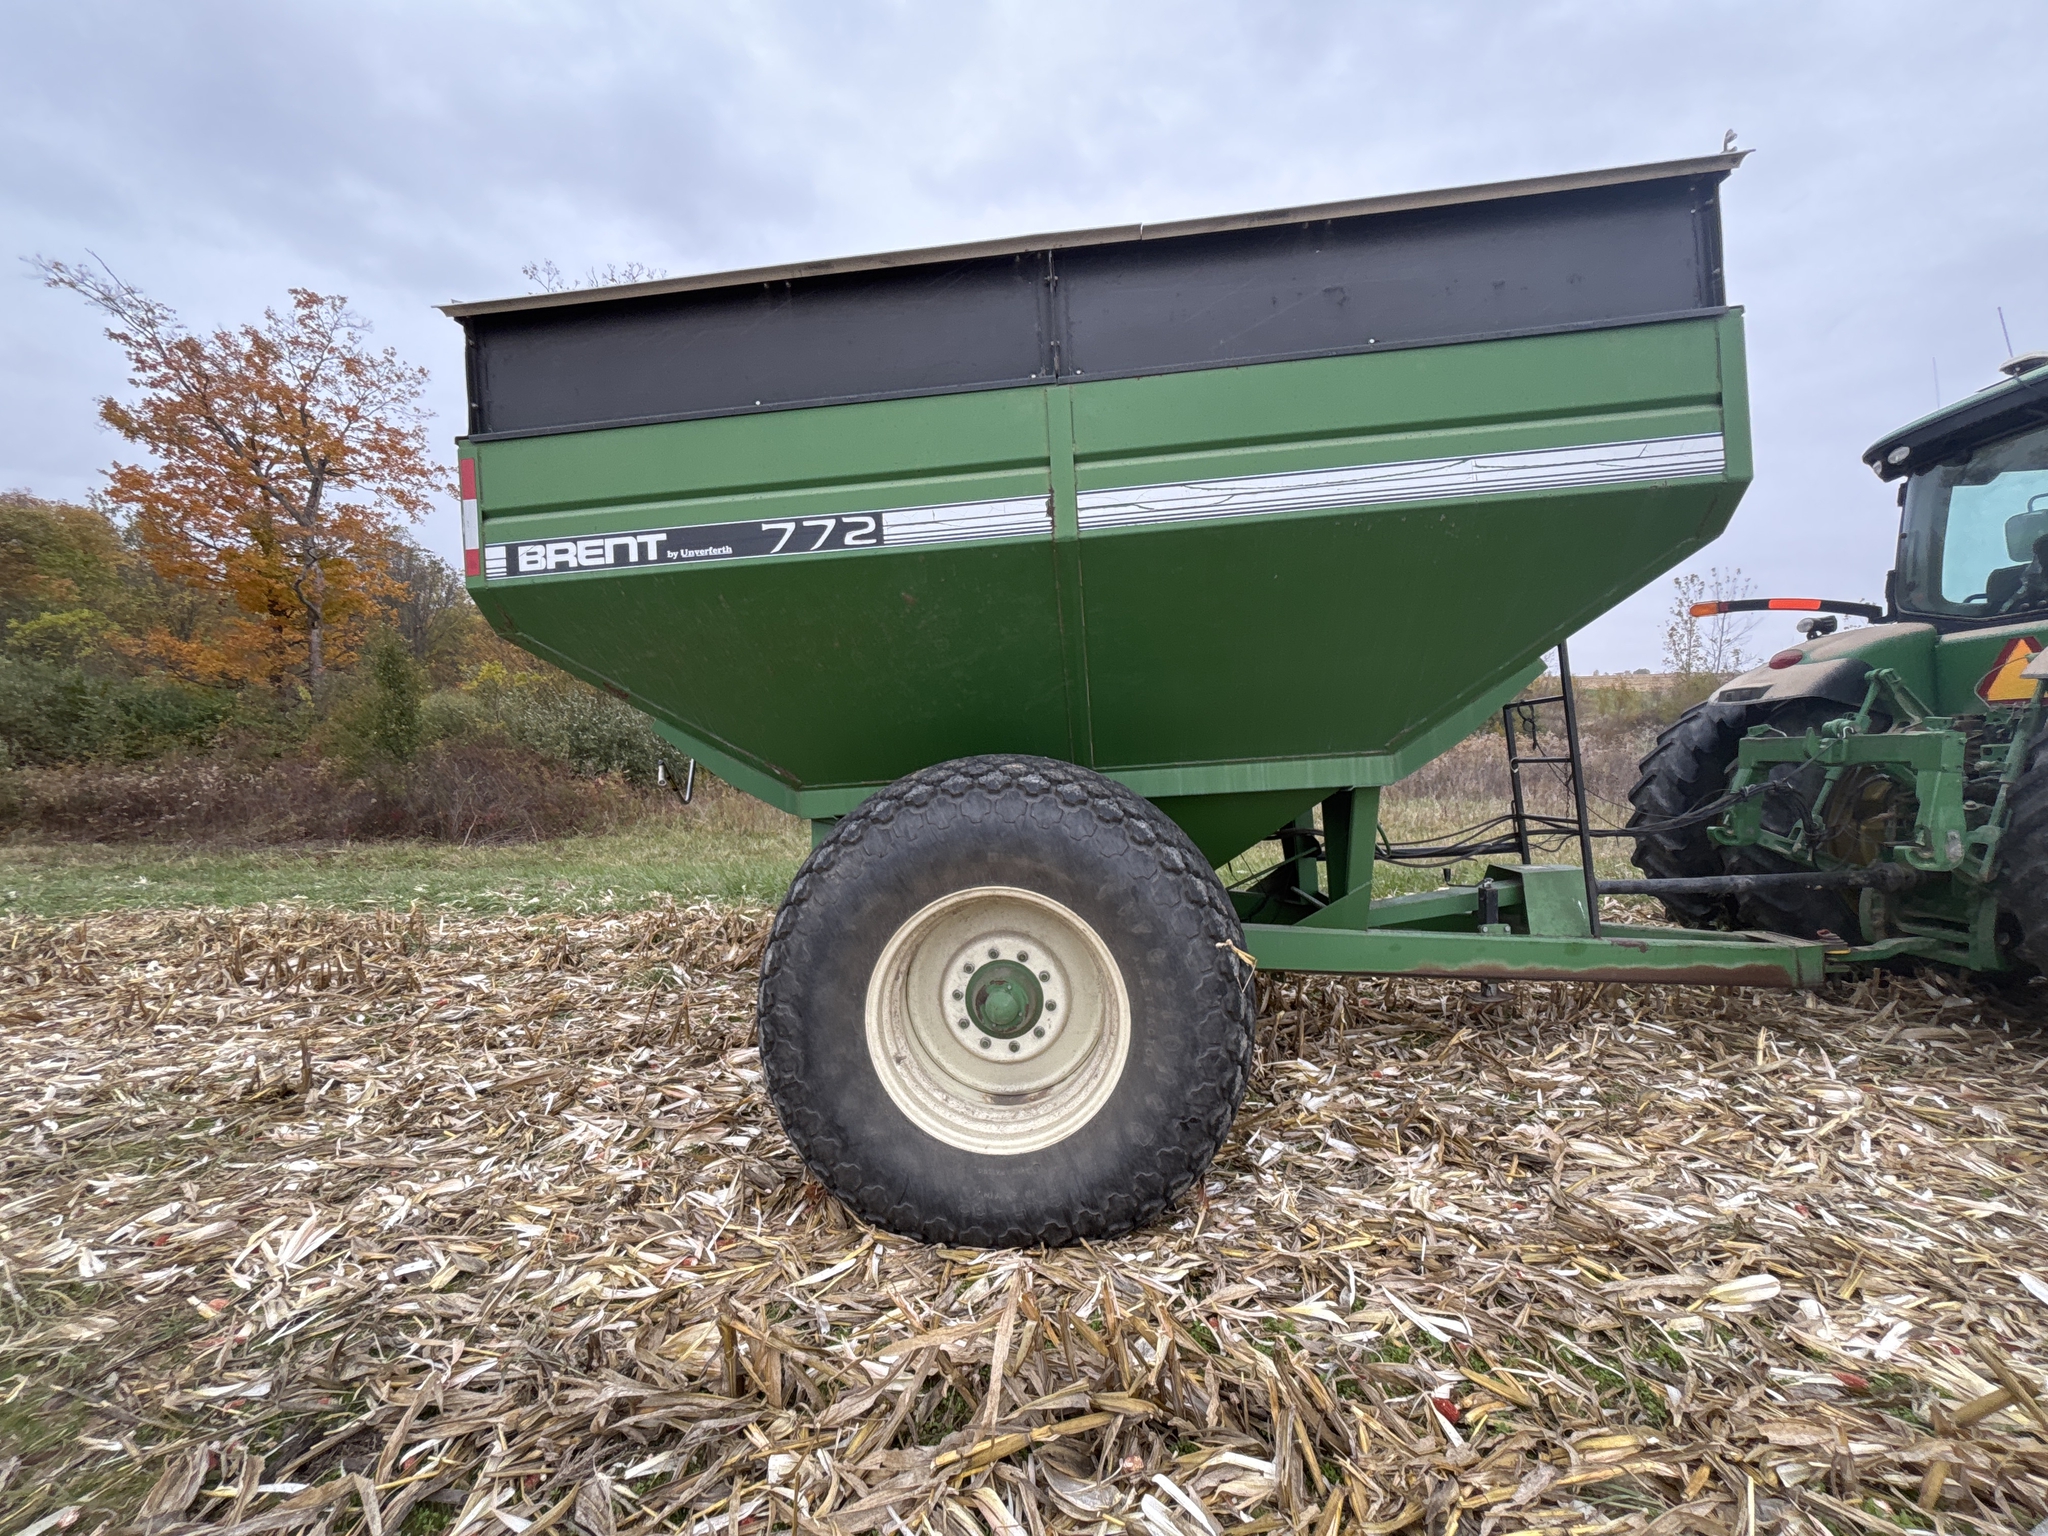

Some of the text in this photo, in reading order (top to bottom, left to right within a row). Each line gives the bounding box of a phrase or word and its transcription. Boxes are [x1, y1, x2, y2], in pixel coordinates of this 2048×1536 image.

[518, 516, 877, 572] BRENT by Unverferth 772
